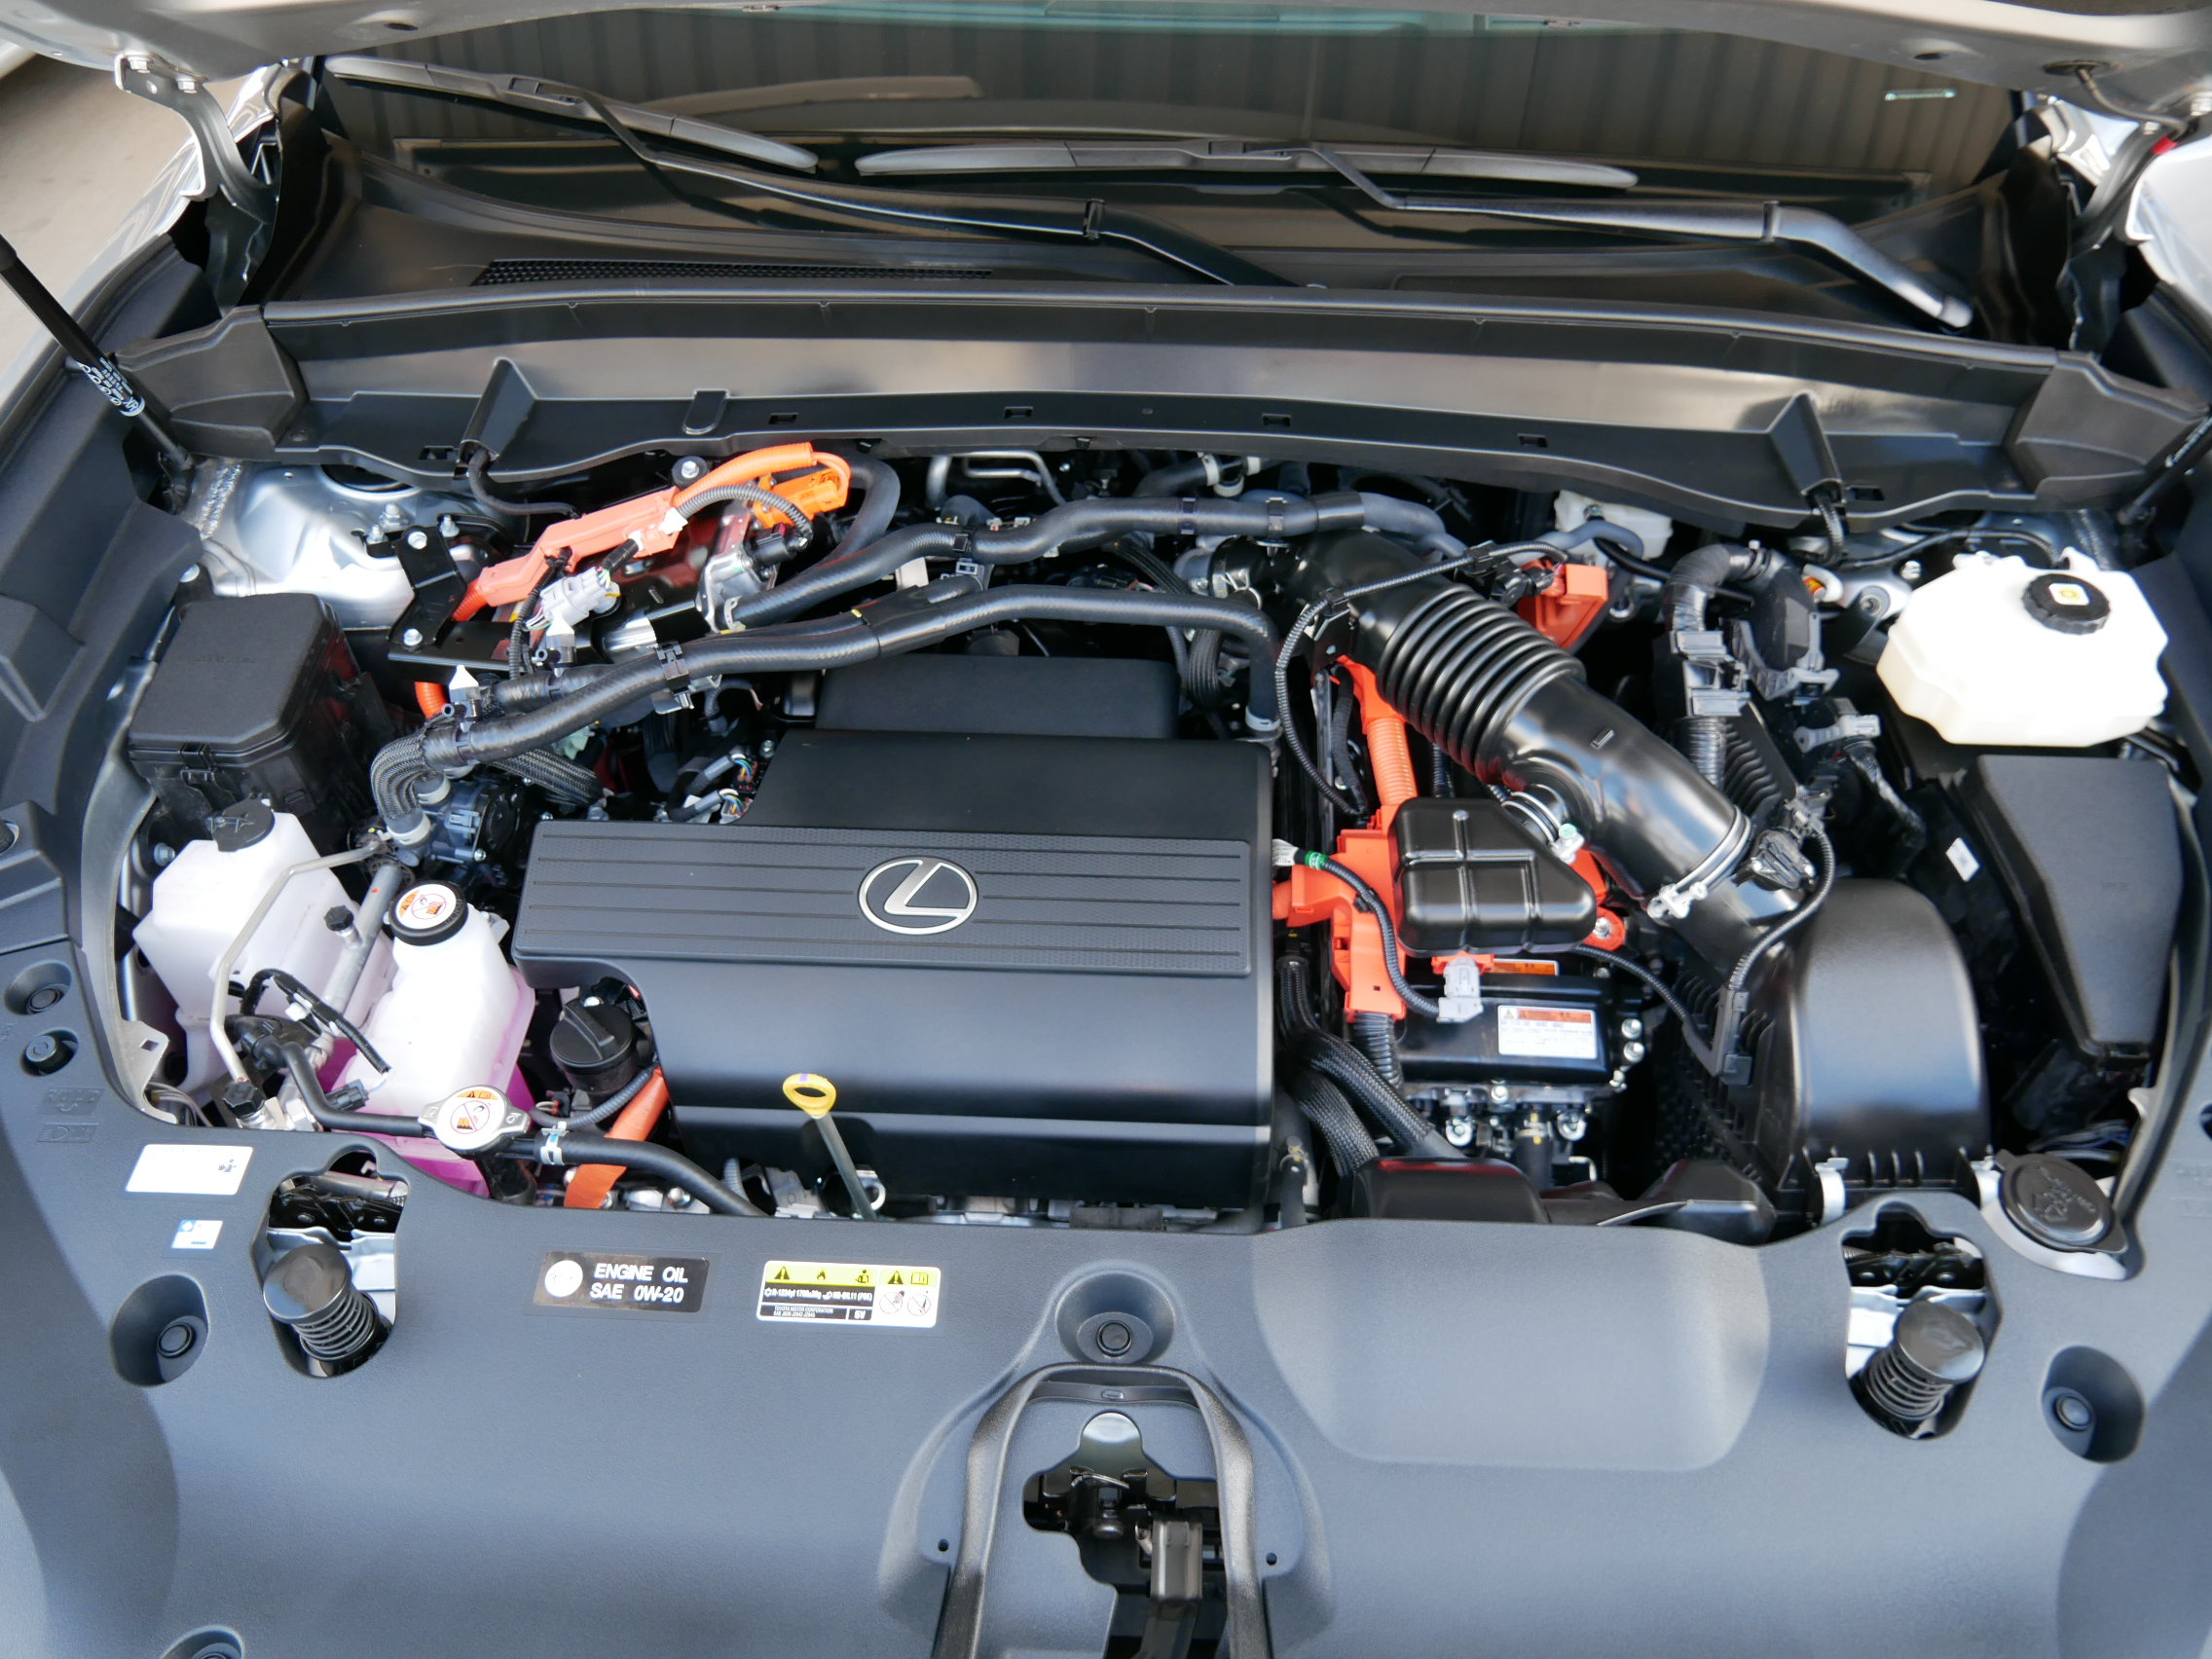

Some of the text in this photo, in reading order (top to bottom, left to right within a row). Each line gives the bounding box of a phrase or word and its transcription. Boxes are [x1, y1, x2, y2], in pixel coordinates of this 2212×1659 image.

[593, 1263, 654, 1281] ENGINE
[662, 1266, 688, 1284] OIL
[589, 1282, 684, 1303] SAE 0W-20
